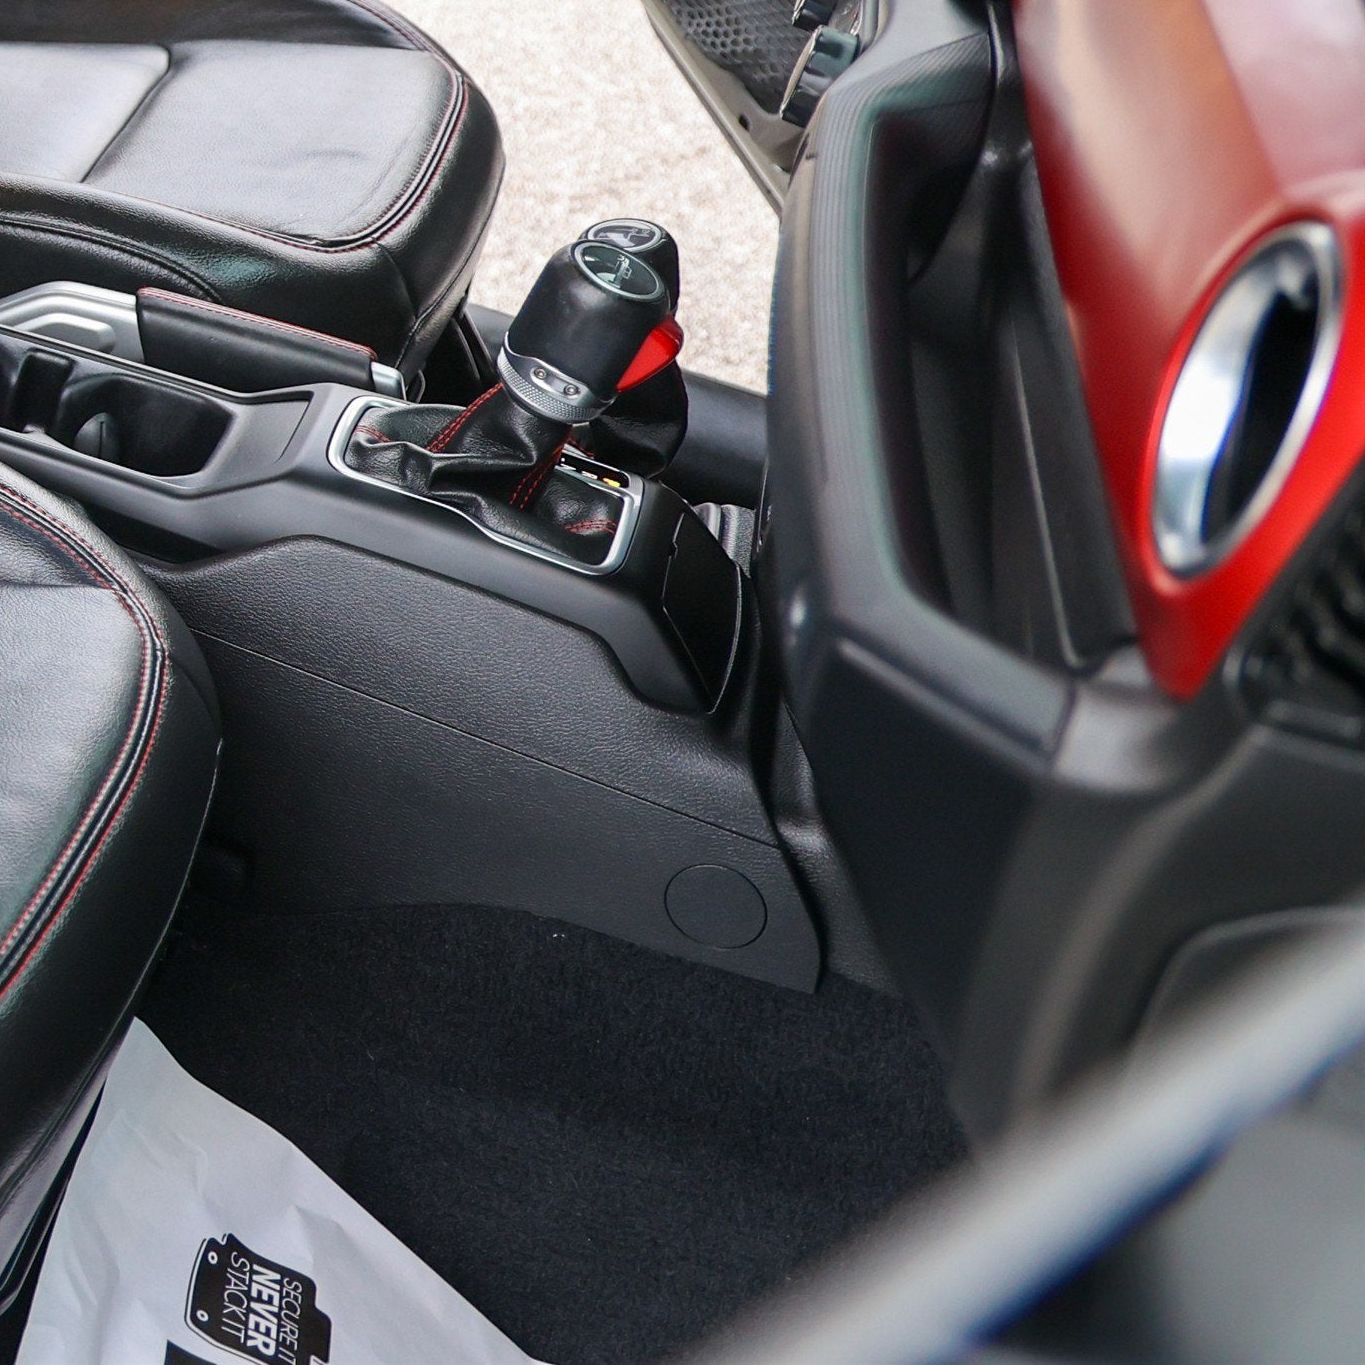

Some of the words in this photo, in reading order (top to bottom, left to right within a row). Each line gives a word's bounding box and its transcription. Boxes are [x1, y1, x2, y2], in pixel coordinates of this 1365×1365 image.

[222, 1251, 251, 1323] STACK
[246, 1263, 282, 1357] NEVER
[278, 1277, 303, 1351] SECURE
[221, 1317, 246, 1344] IT
